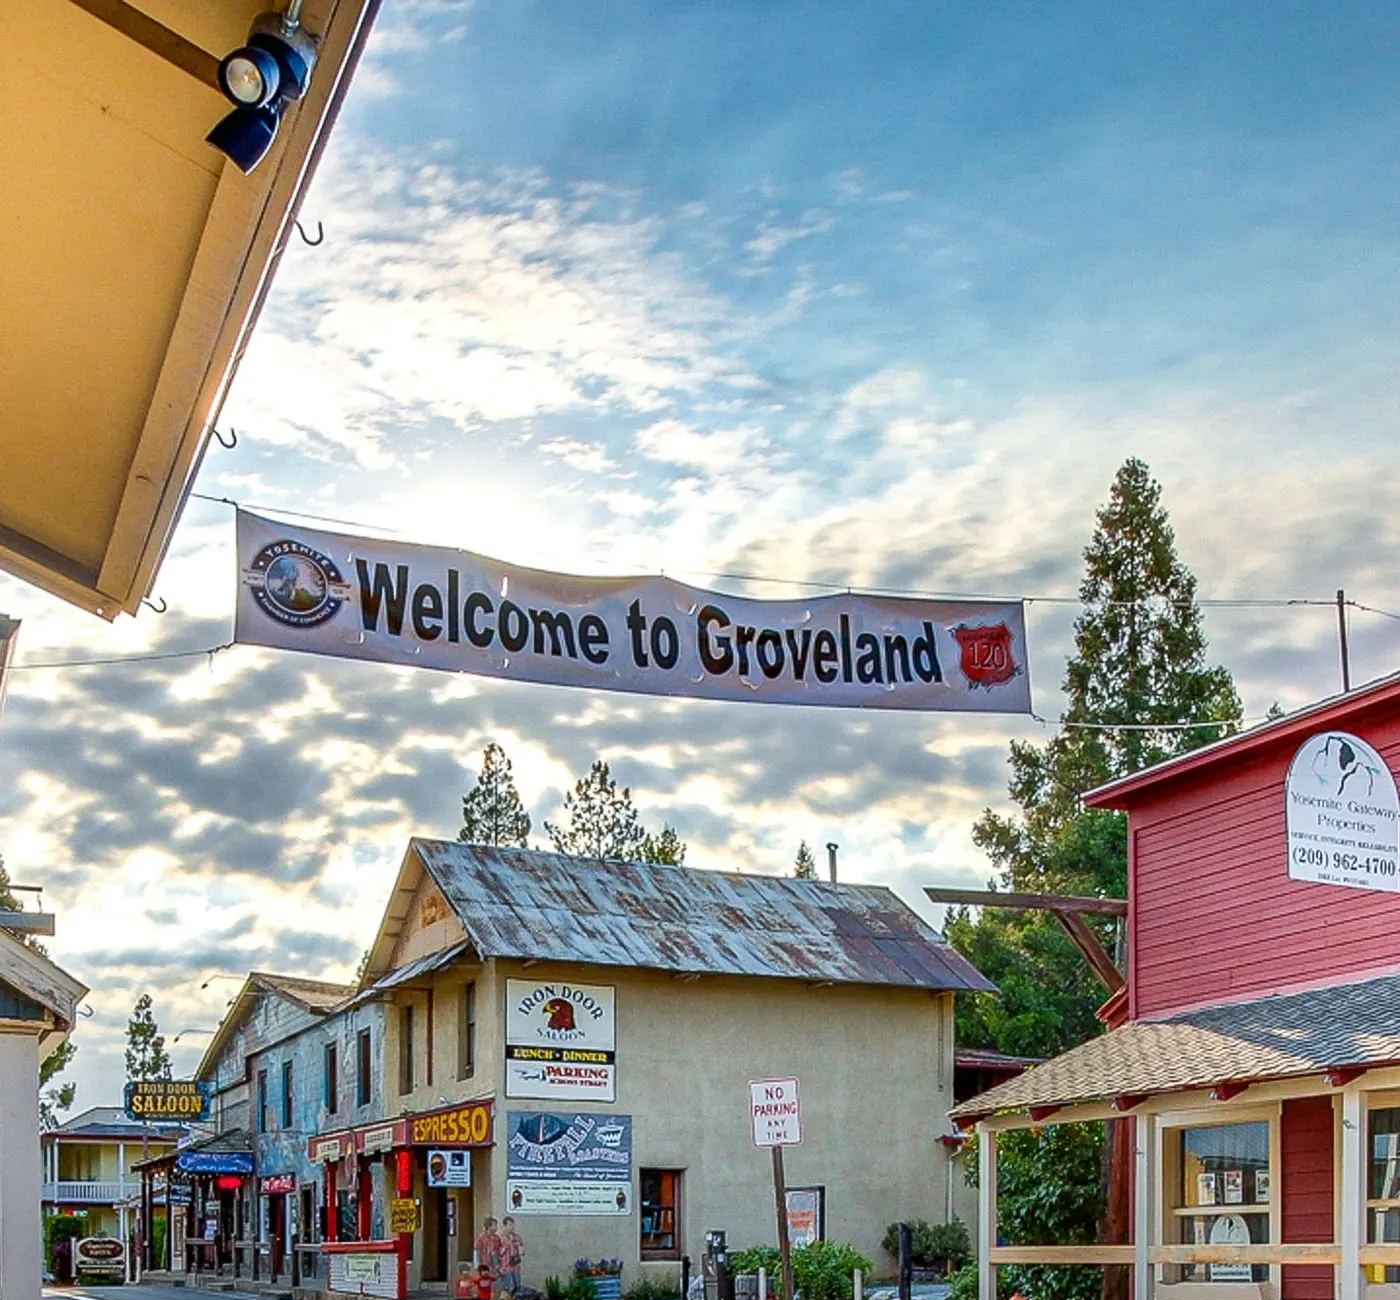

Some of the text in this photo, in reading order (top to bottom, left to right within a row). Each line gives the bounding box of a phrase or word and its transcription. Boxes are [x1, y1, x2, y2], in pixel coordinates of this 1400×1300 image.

[265, 543, 330, 566] YOSEMITE
[355, 558, 943, 685] Welcome to Groveland
[969, 642, 1007, 671] 120
[1291, 791, 1398, 822] Yosemite Gateway
[1317, 813, 1377, 833] Properties
[1292, 847, 1396, 876] (209) 962-4700
[518, 985, 604, 1020] IRON DOOR
[536, 1028, 586, 1041] SALOON
[513, 1048, 607, 1063] LUNCH DINNER
[545, 1066, 608, 1080] PARKING
[137, 1083, 196, 1094] IRON DOOR
[765, 1087, 784, 1100] NO
[131, 1095, 203, 1113] SALOON
[754, 1101, 797, 1117] PARKING
[413, 1106, 490, 1143] ESPRESSO
[767, 1131, 787, 1140] TIME
